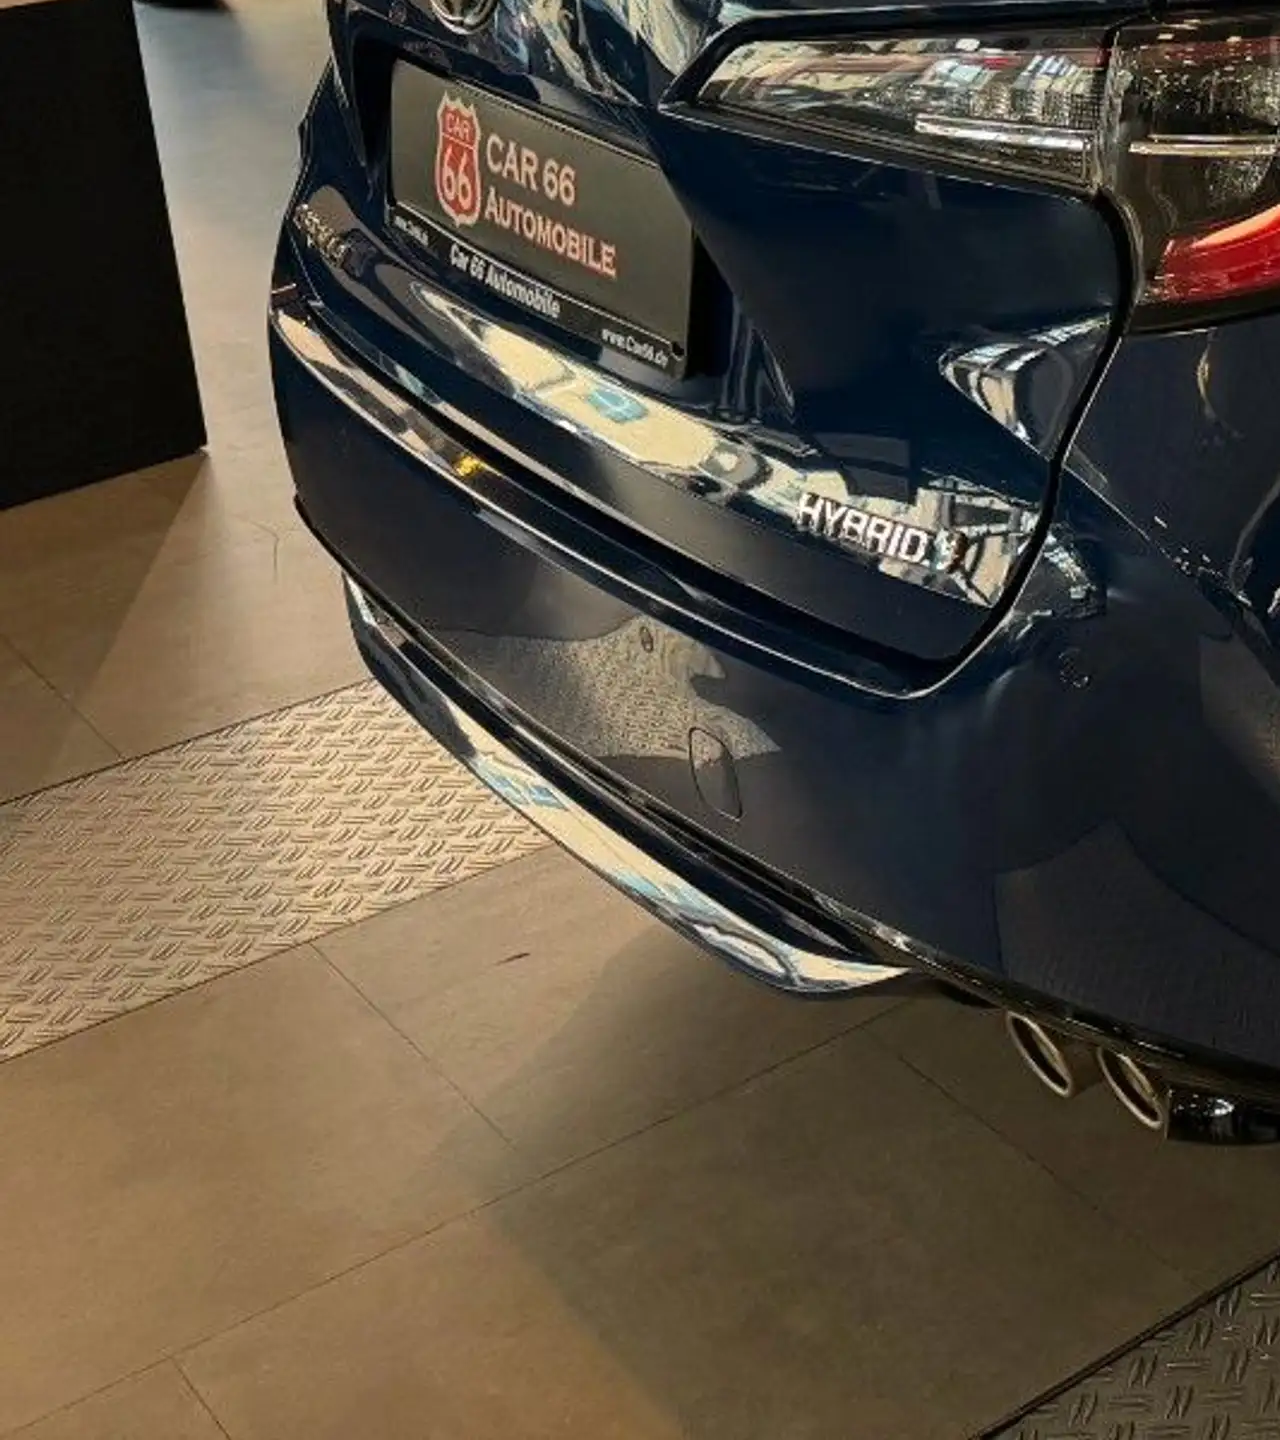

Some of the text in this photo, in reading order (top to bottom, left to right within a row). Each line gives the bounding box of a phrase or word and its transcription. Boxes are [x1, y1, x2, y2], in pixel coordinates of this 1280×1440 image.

[446, 112, 471, 141] CAR
[443, 146, 472, 210] 66
[486, 133, 577, 207] CAR 66
[484, 185, 617, 279] AUTOMOBILE
[450, 243, 470, 272] Car
[485, 268, 561, 319] Automobile
[797, 492, 928, 563] HYBRID
